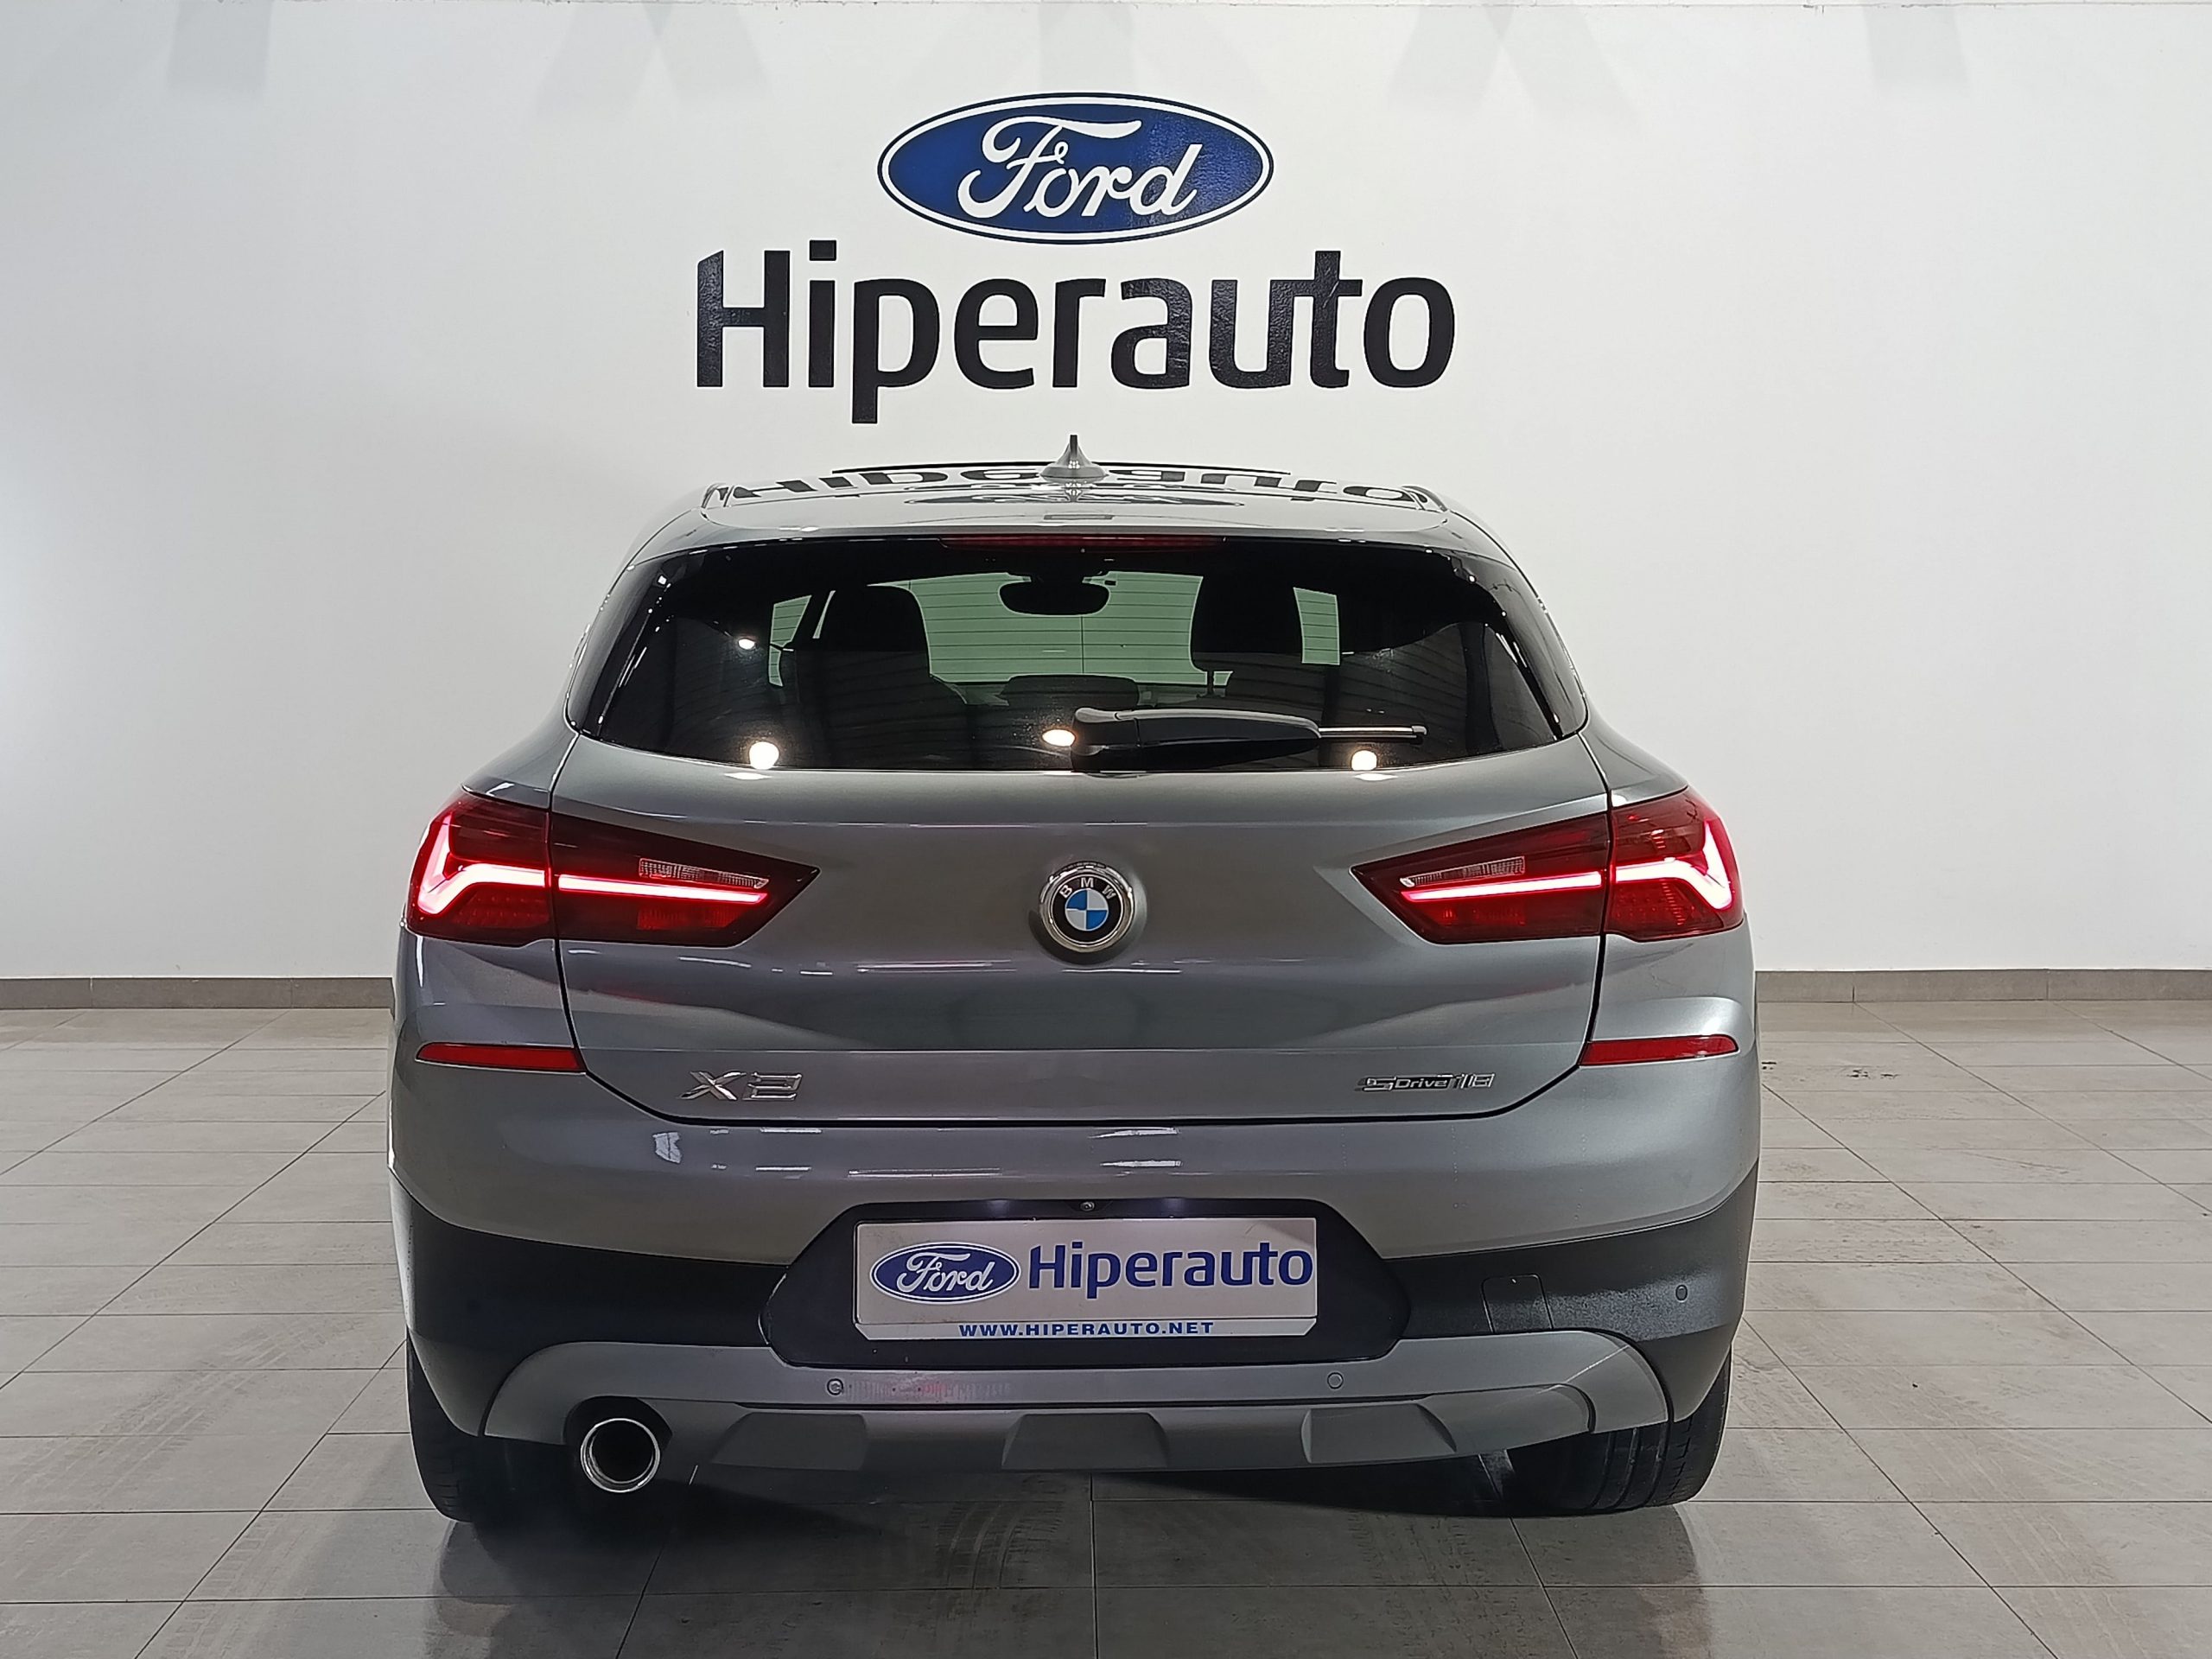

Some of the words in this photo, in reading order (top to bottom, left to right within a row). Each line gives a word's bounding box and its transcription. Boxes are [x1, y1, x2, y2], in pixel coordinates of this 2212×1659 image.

[957, 115, 1203, 218] Ford
[696, 239, 1456, 423] Hiperauto
[1059, 877, 1116, 899] BMW
[896, 1251, 995, 1292] Ford
[1028, 1242, 1313, 1300] Hiperauto
[959, 1321, 1214, 1337] WWW.HIPERAUTO.NET
